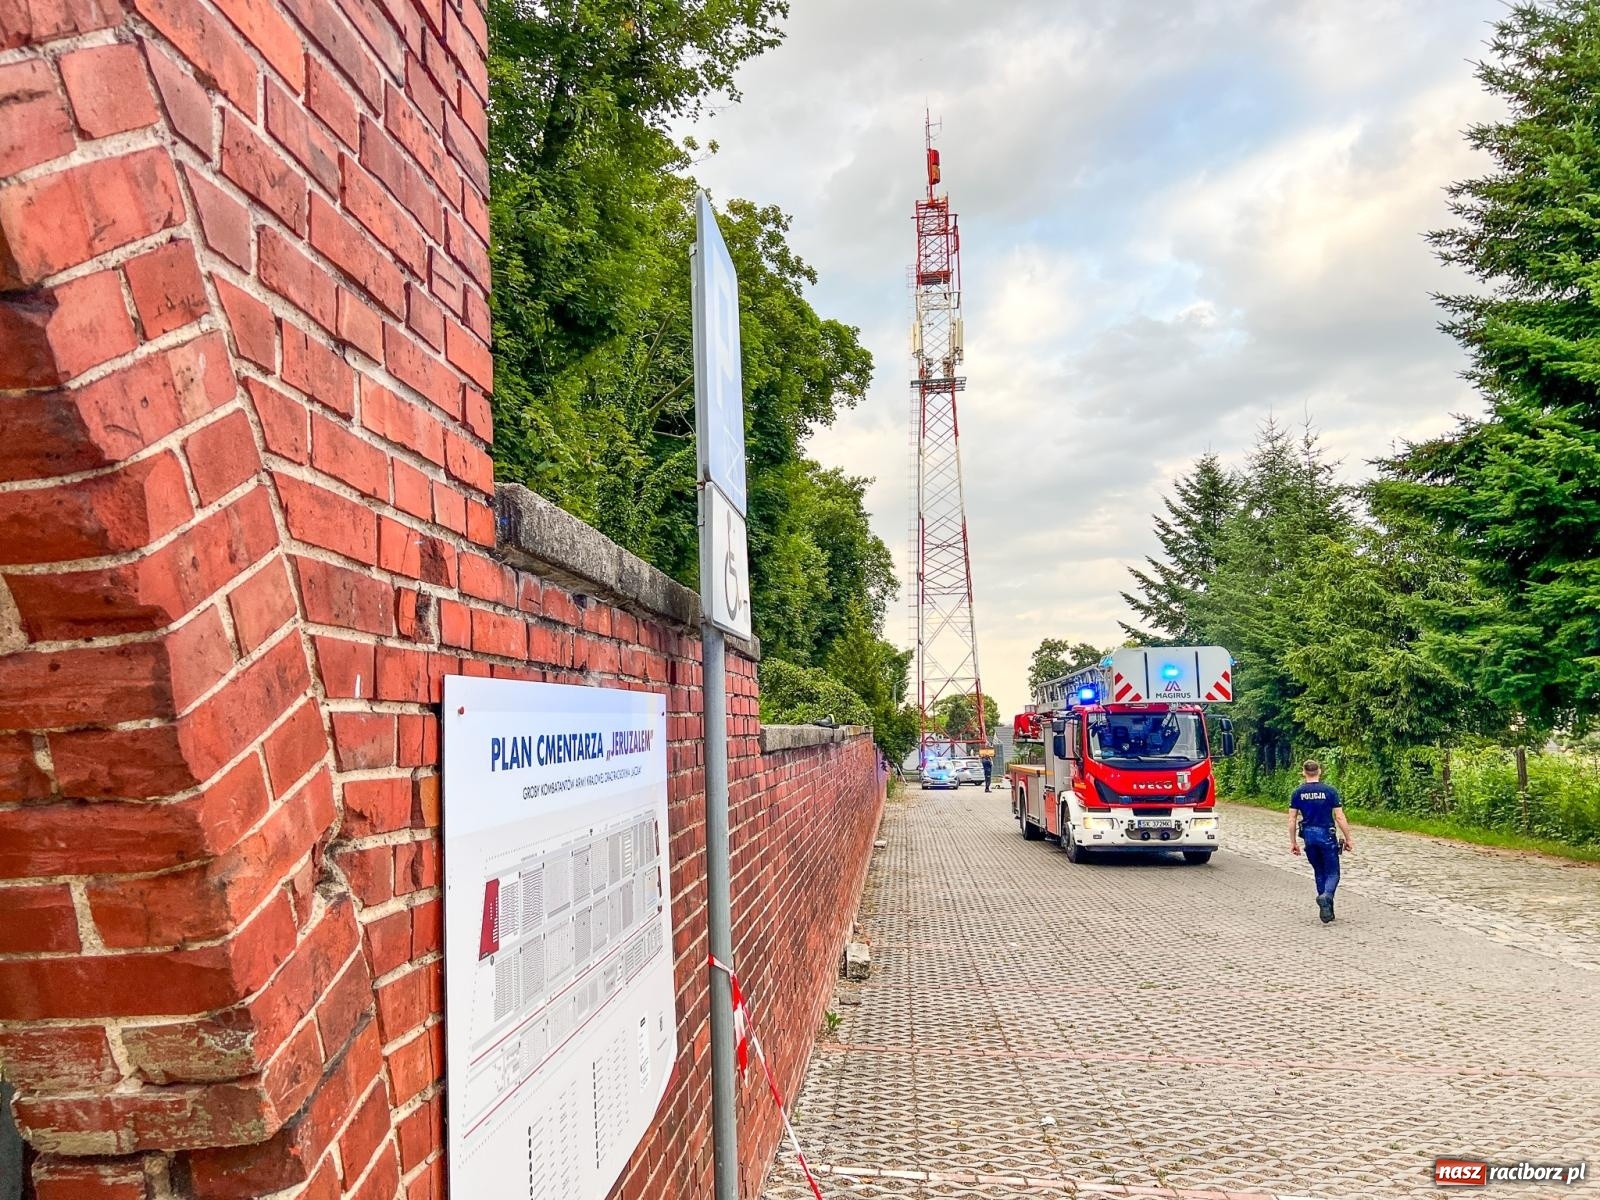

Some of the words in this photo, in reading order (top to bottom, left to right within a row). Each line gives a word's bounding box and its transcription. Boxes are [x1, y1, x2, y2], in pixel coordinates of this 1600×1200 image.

[491, 735, 532, 772] PLAN
[537, 732, 604, 766] CMENTARZA
[1133, 781, 1173, 790] IVECO
[1300, 792, 1326, 801] POLICJA
